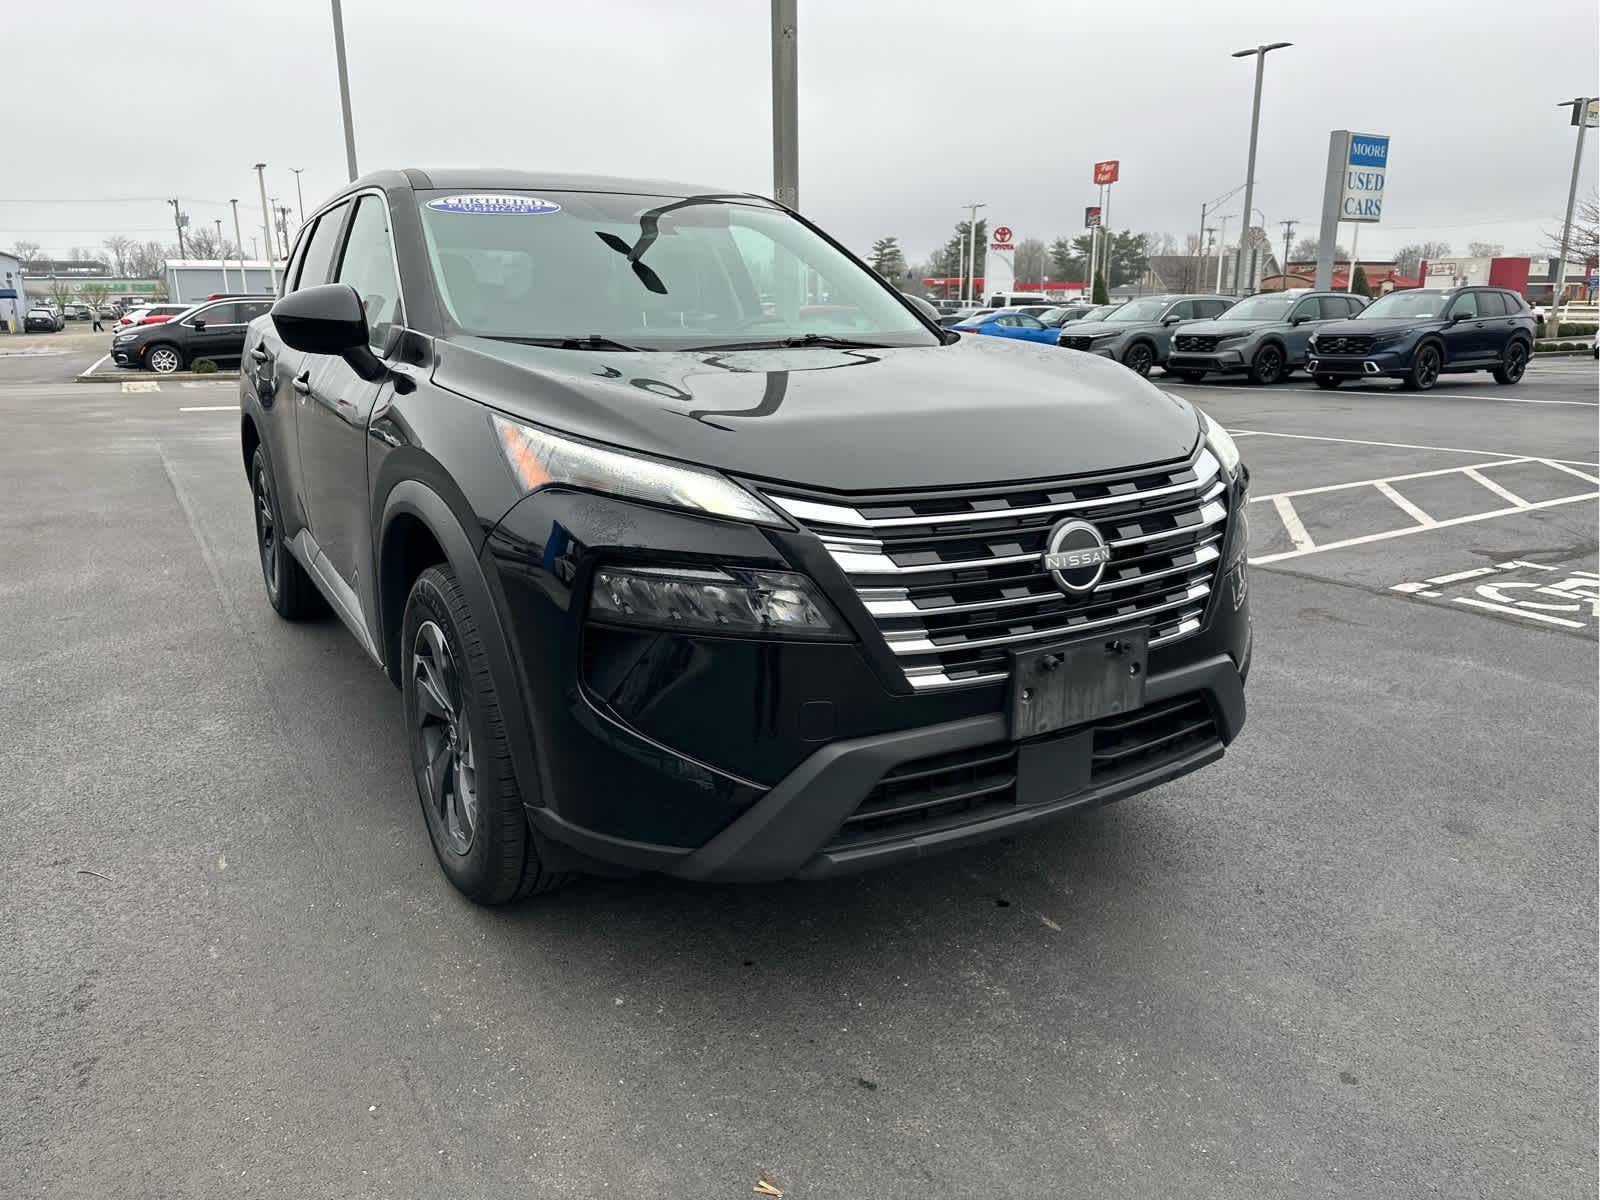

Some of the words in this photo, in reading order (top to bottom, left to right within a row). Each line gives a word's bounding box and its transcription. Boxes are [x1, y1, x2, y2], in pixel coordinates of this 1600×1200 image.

[1353, 142, 1386, 157] MOORE
[1348, 172, 1385, 191] USED
[442, 197, 546, 206] CERTIFIED
[463, 205, 529, 213] VEHICLE
[1344, 197, 1382, 217] CARS
[1047, 549, 1110, 569] NISSAN
